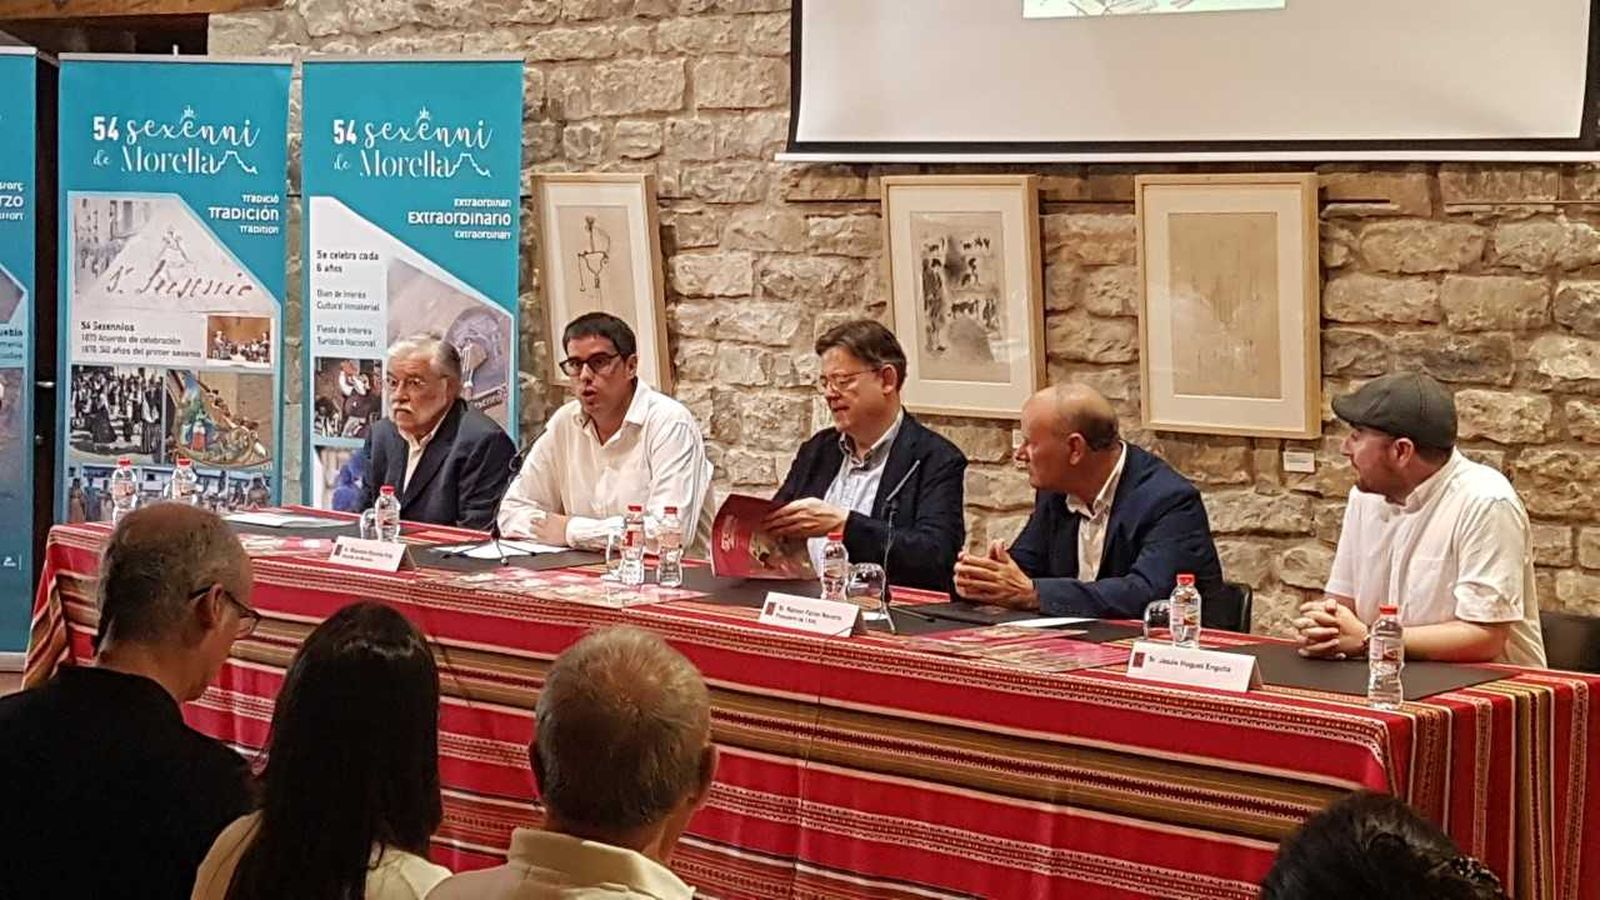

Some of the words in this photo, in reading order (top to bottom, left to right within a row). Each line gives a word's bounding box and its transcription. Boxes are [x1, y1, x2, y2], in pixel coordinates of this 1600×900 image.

[93, 116, 119, 141] 54
[333, 119, 357, 144] 54
[92, 149, 111, 167] de
[120, 145, 258, 174] Morella
[333, 153, 351, 171] de
[359, 149, 491, 178] Morella
[330, 251, 357, 261] celebra
[359, 251, 380, 261] cada
